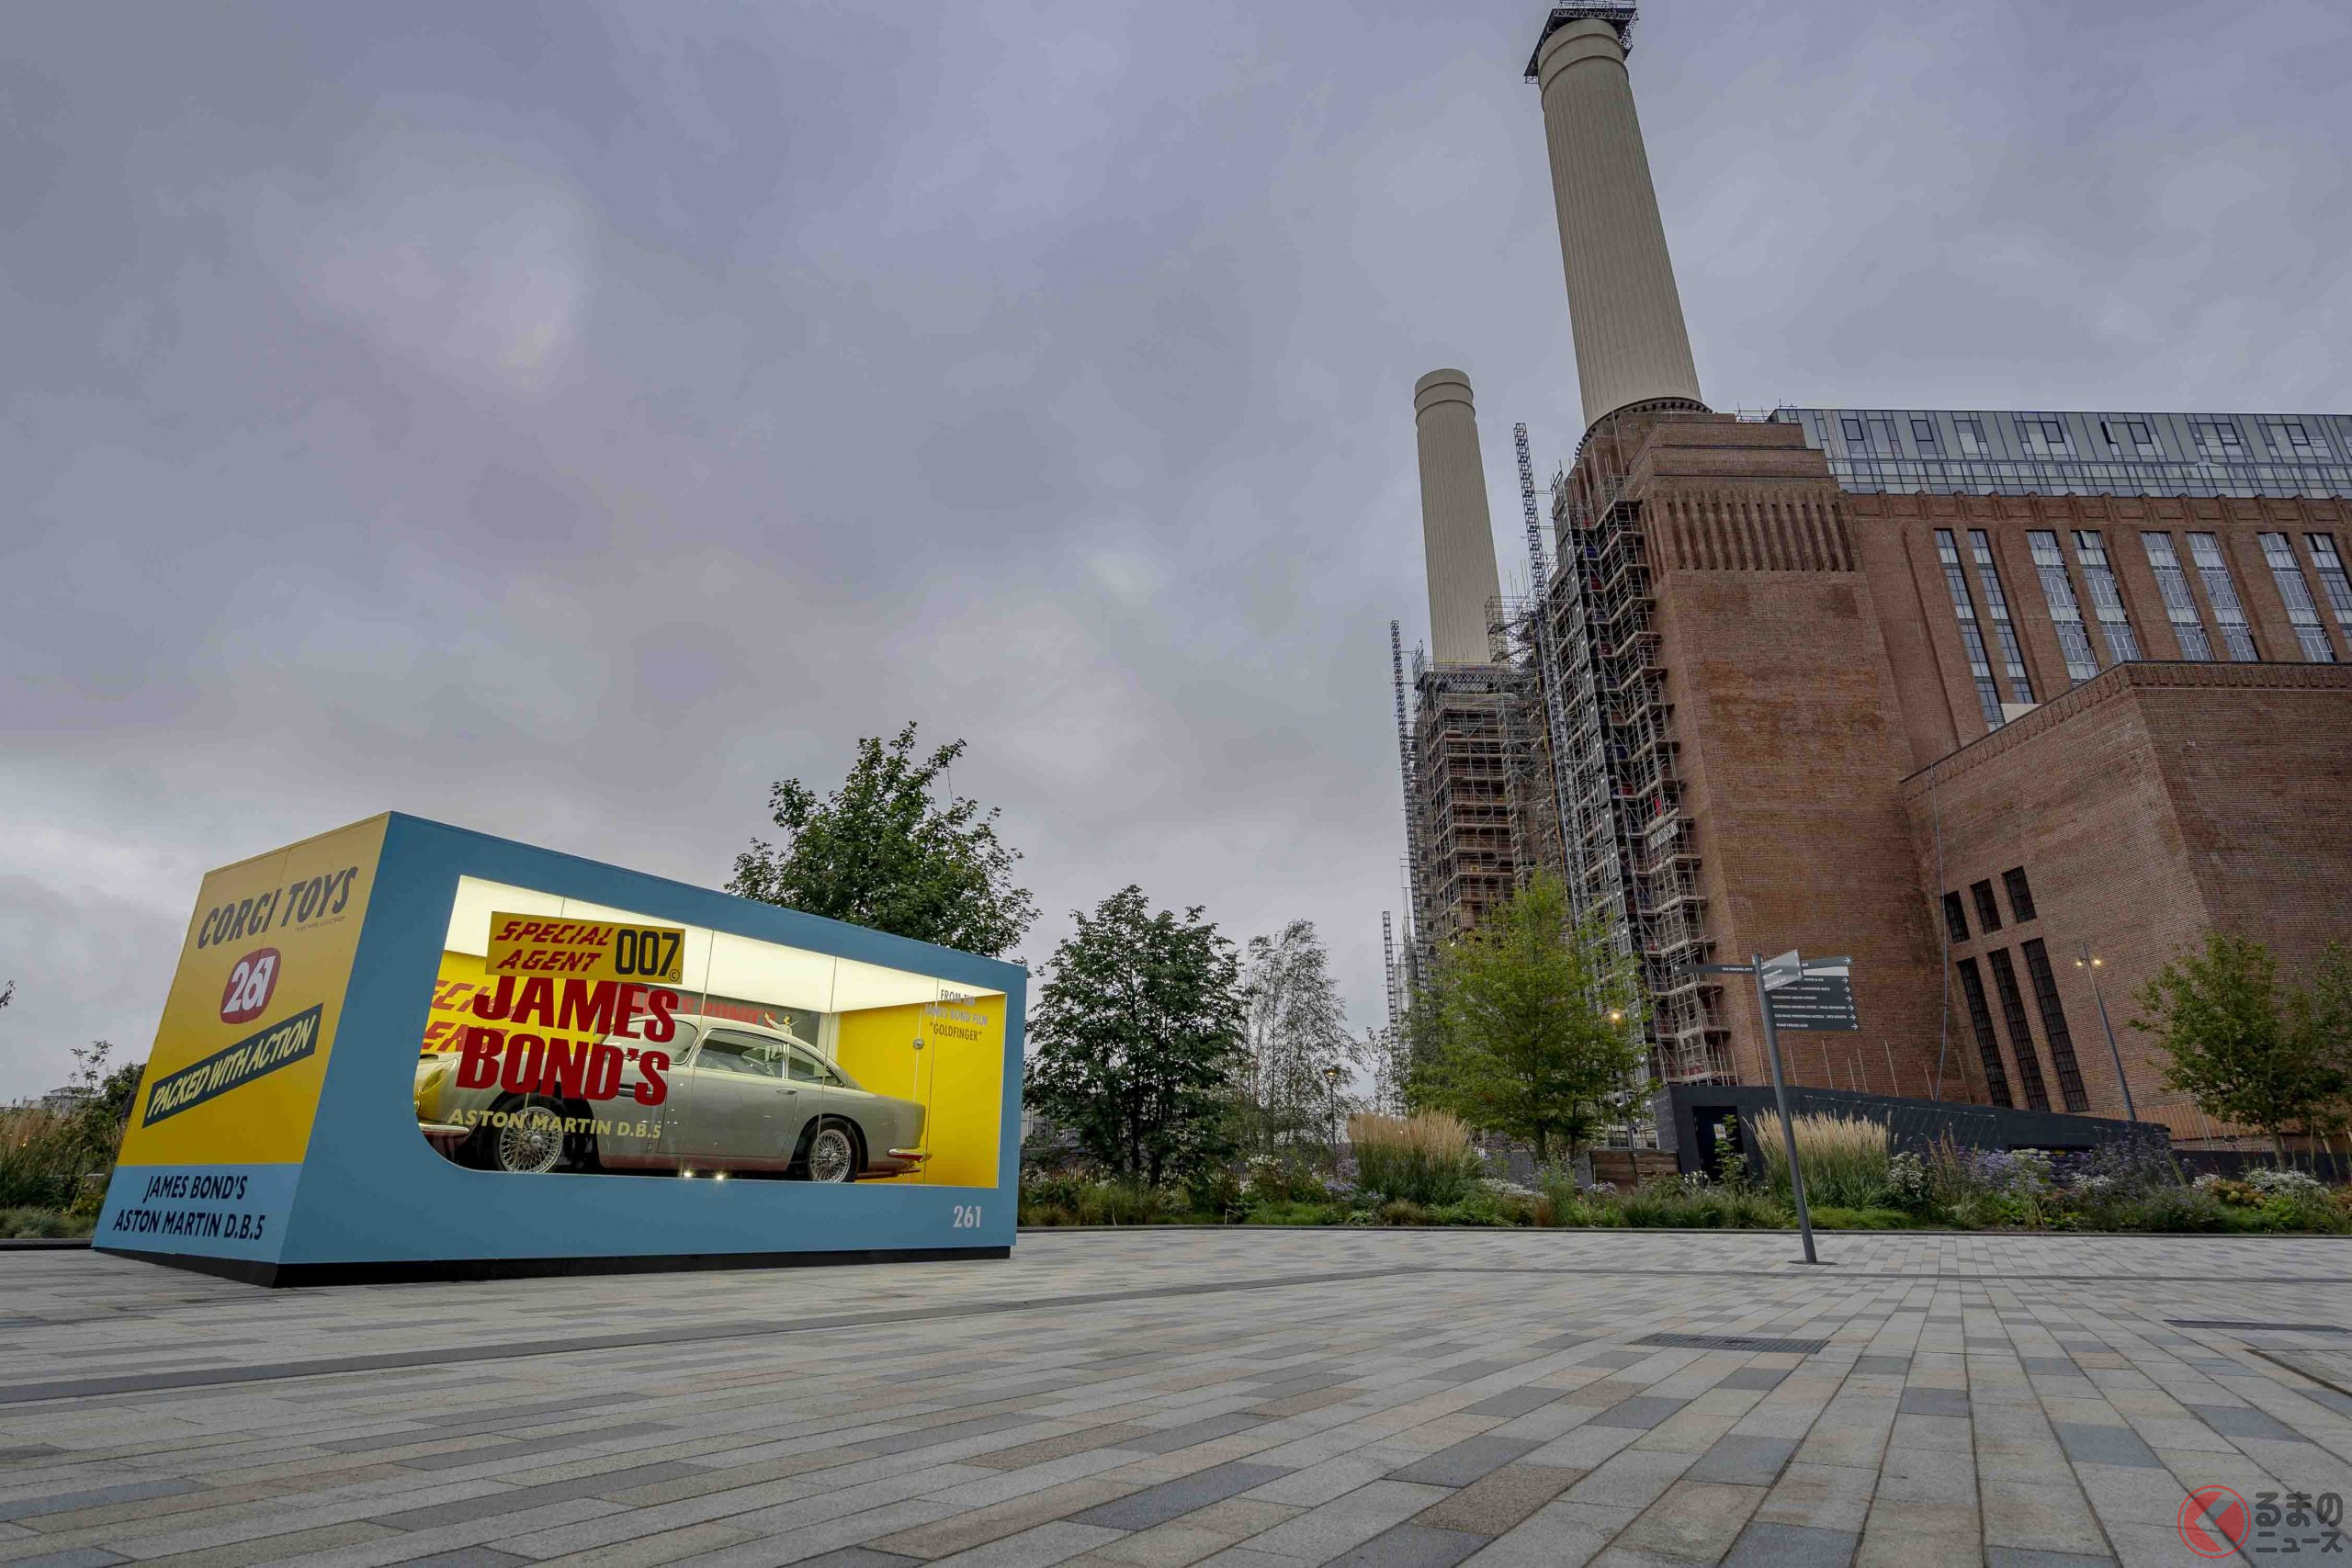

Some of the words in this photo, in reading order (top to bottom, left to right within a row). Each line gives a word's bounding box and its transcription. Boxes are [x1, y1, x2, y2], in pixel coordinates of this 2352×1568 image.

[198, 888, 282, 949] CORGI
[280, 866, 358, 927] TOYS
[494, 921, 615, 946] SPECIAL
[496, 949, 602, 972] AGENT
[615, 929, 681, 976] 007
[222, 955, 276, 1014] 261
[941, 989, 962, 1003] FROM
[472, 976, 679, 1043] JAMES
[147, 1065, 211, 1118] PACKED
[207, 1045, 253, 1092] WITH
[245, 1014, 317, 1075] ACTION
[456, 1026, 671, 1106] BOND'S
[447, 1108, 526, 1129] ASTON
[532, 1113, 612, 1135] MARTIN
[616, 1122, 662, 1139] D.B.5
[142, 1175, 189, 1204] JAMES
[189, 1175, 248, 1201] BOND'S
[113, 1209, 162, 1234] ASTON
[162, 1211, 222, 1238] MARTIN
[223, 1213, 266, 1241] D.B.5
[953, 1205, 981, 1228] 261
